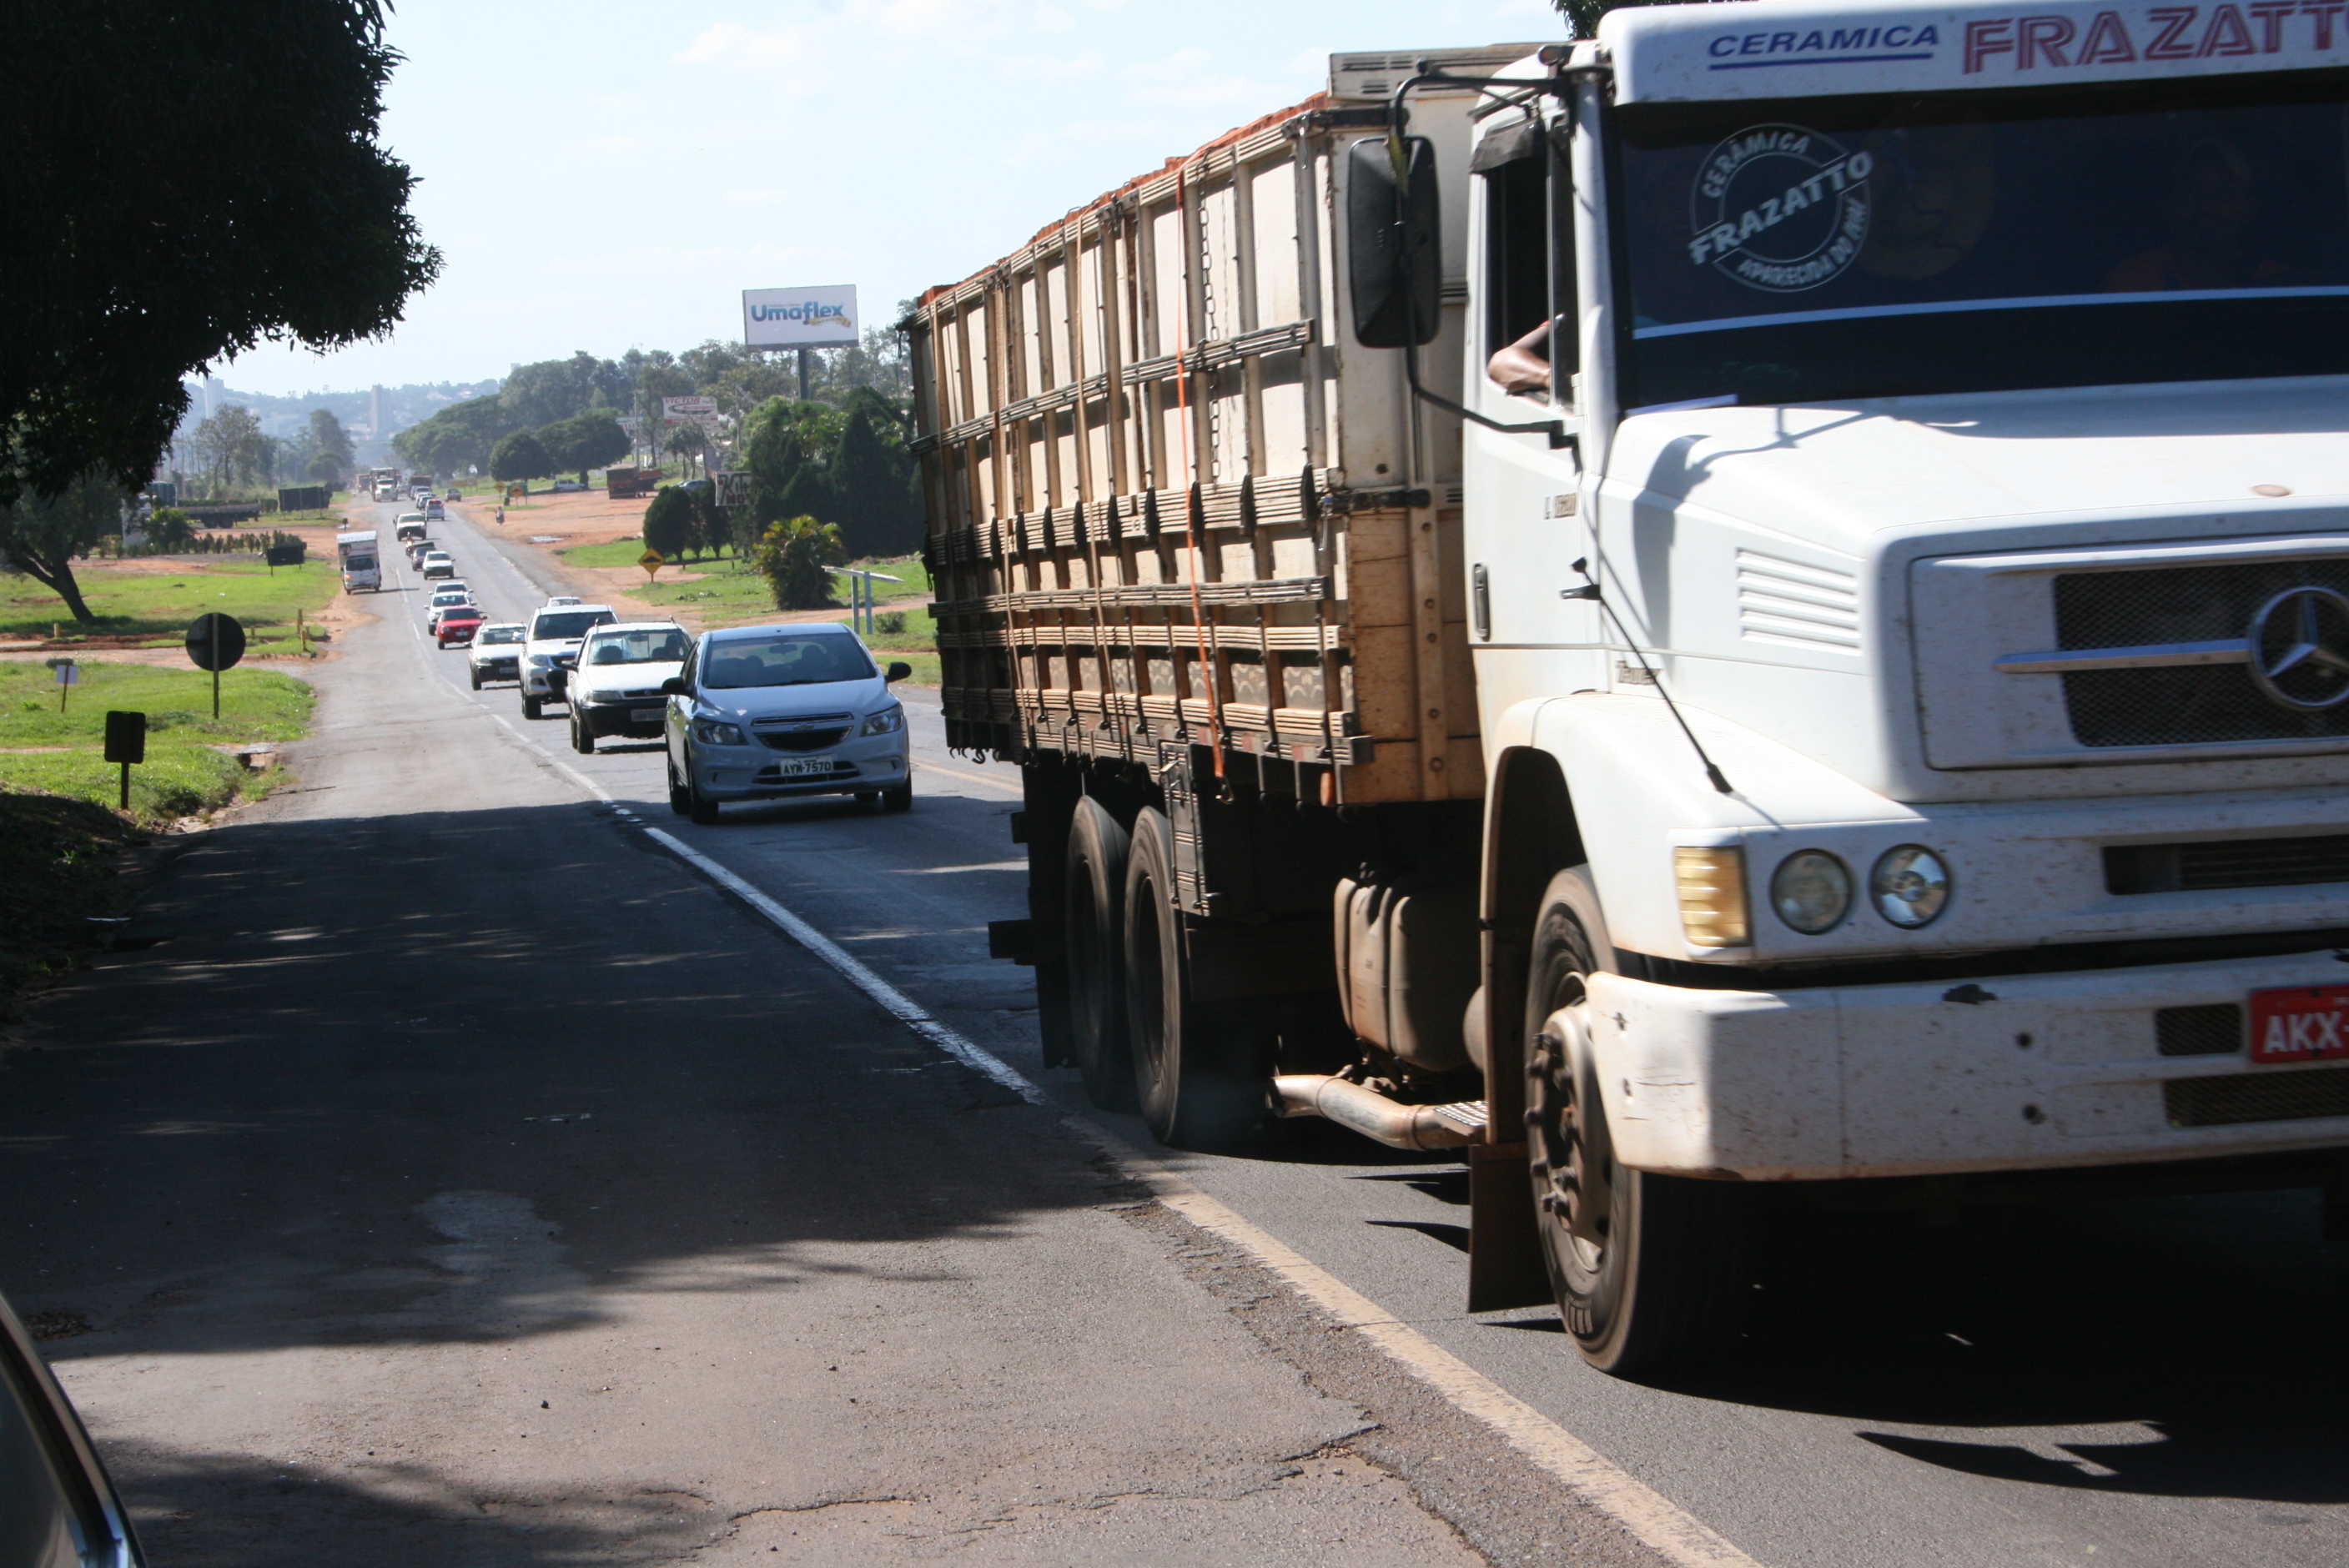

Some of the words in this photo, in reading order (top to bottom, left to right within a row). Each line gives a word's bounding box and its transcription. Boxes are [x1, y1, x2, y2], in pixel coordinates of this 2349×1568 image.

[1708, 25, 1939, 58] CERAMICA
[1963, 0, 2349, 74] FRAZATT
[1688, 150, 1873, 265] FRAZATTO
[751, 301, 844, 325] Umaflex
